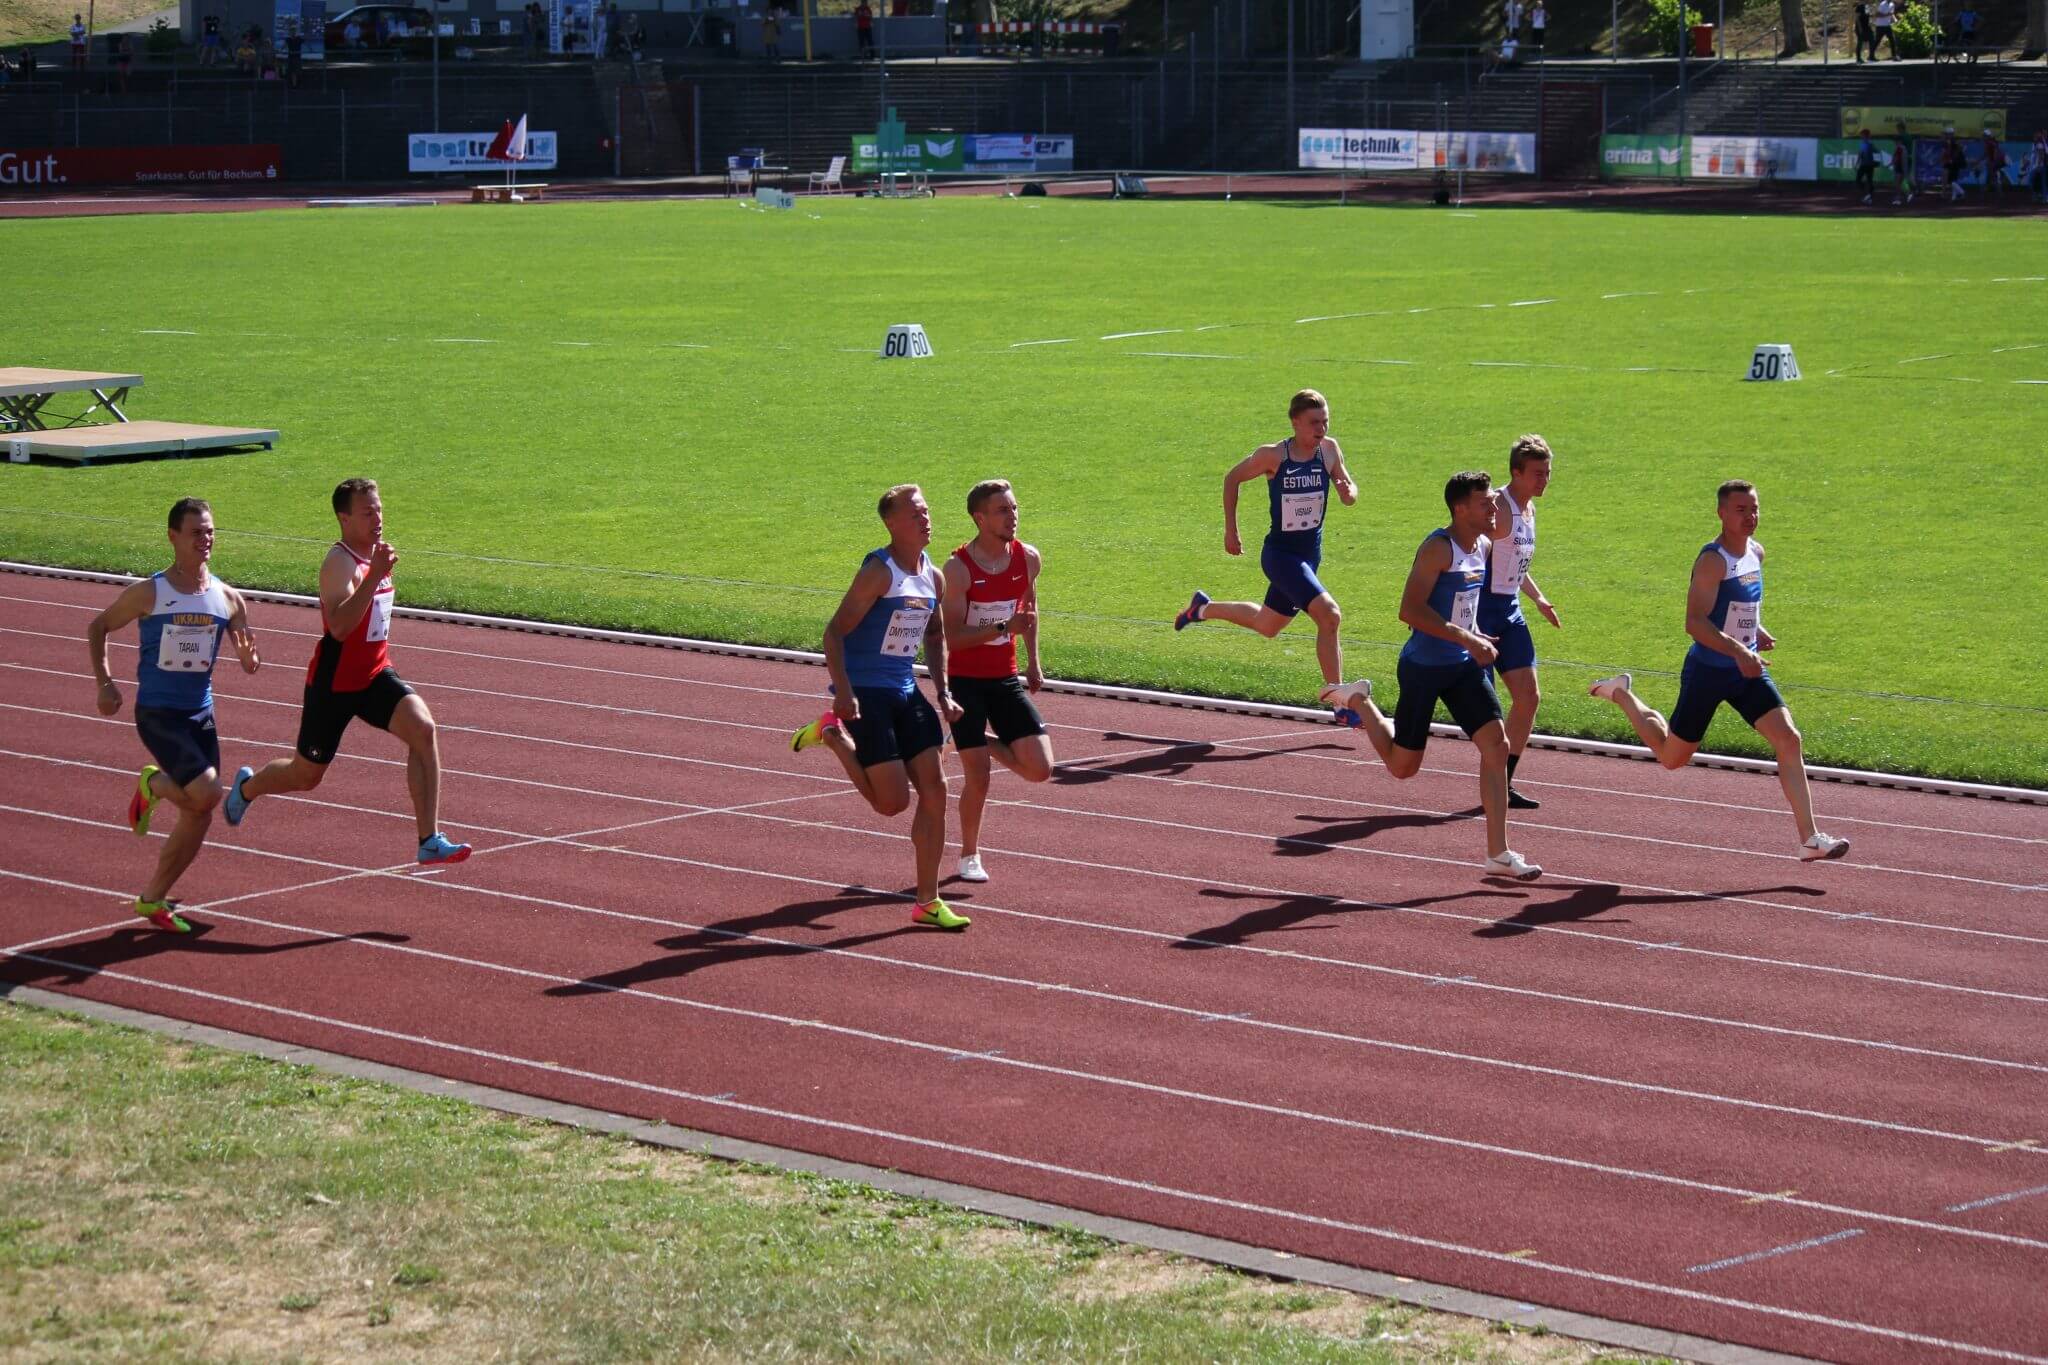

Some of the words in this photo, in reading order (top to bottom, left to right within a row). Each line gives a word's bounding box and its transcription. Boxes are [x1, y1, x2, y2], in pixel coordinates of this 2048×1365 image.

[1605, 147, 1653, 164] erima
[0, 152, 67, 184] Gut.
[188, 170, 206, 180] Gut
[207, 169, 221, 180] für
[885, 332, 908, 357] 60
[911, 331, 928, 356] 60
[1752, 353, 1779, 379] 50
[1781, 352, 1797, 379] 50
[15, 443, 22, 457] 3
[1284, 475, 1322, 488] ESTONIA
[172, 614, 215, 625] UKRAINE
[179, 642, 200, 653] TARAN
